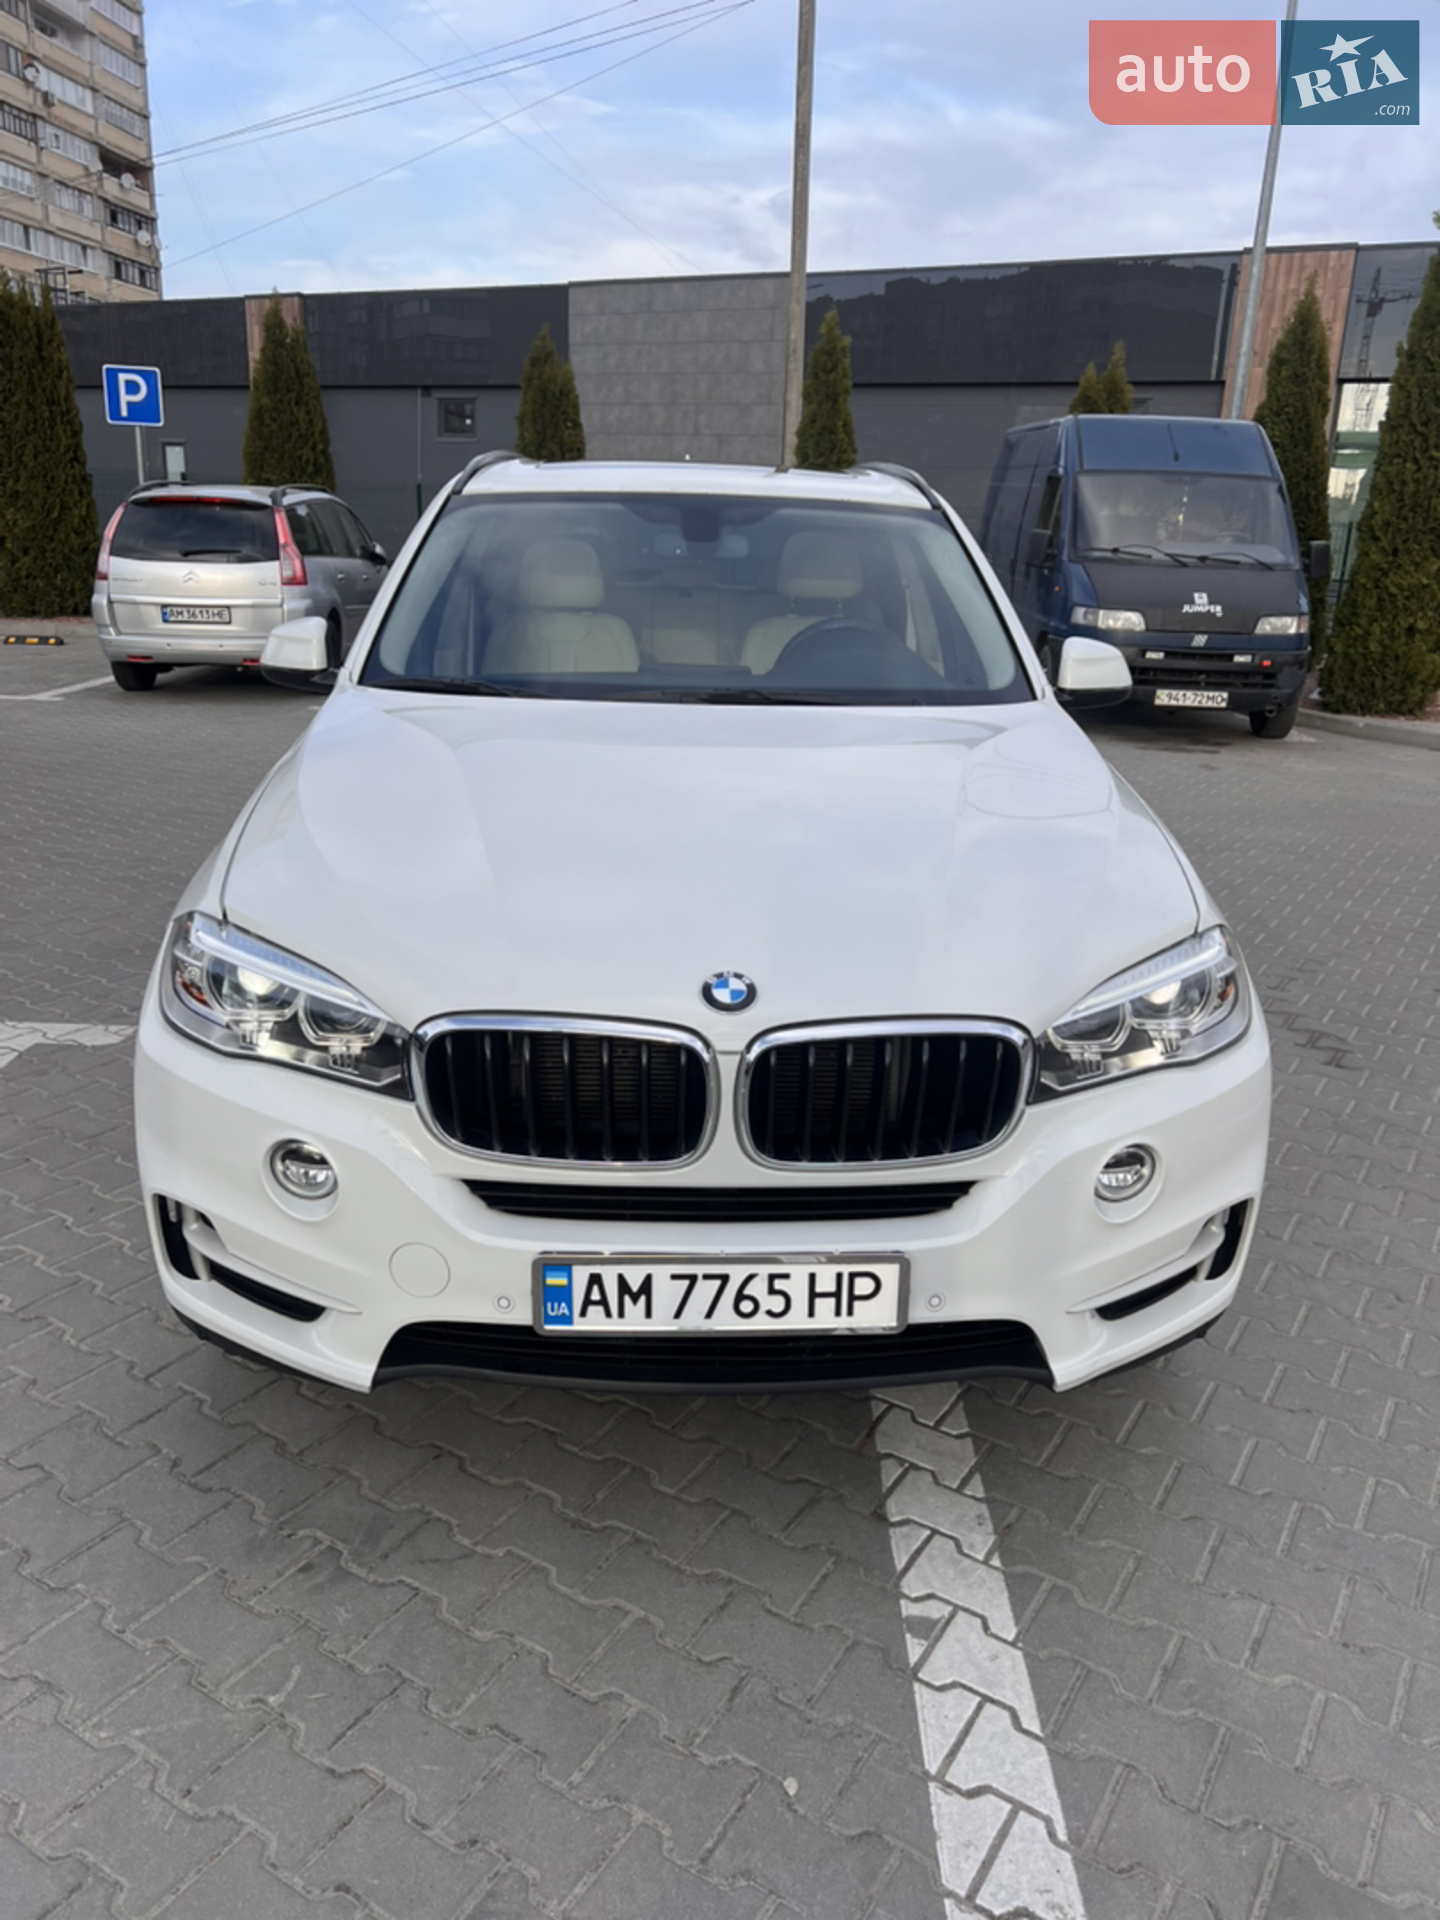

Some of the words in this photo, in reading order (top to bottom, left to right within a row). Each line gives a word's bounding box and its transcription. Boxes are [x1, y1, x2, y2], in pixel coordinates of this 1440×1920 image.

[117, 372, 148, 418] P
[546, 1302, 570, 1316] UA
[578, 1272, 653, 1319] AM
[669, 1272, 792, 1320] 7765
[807, 1271, 883, 1318] HP
